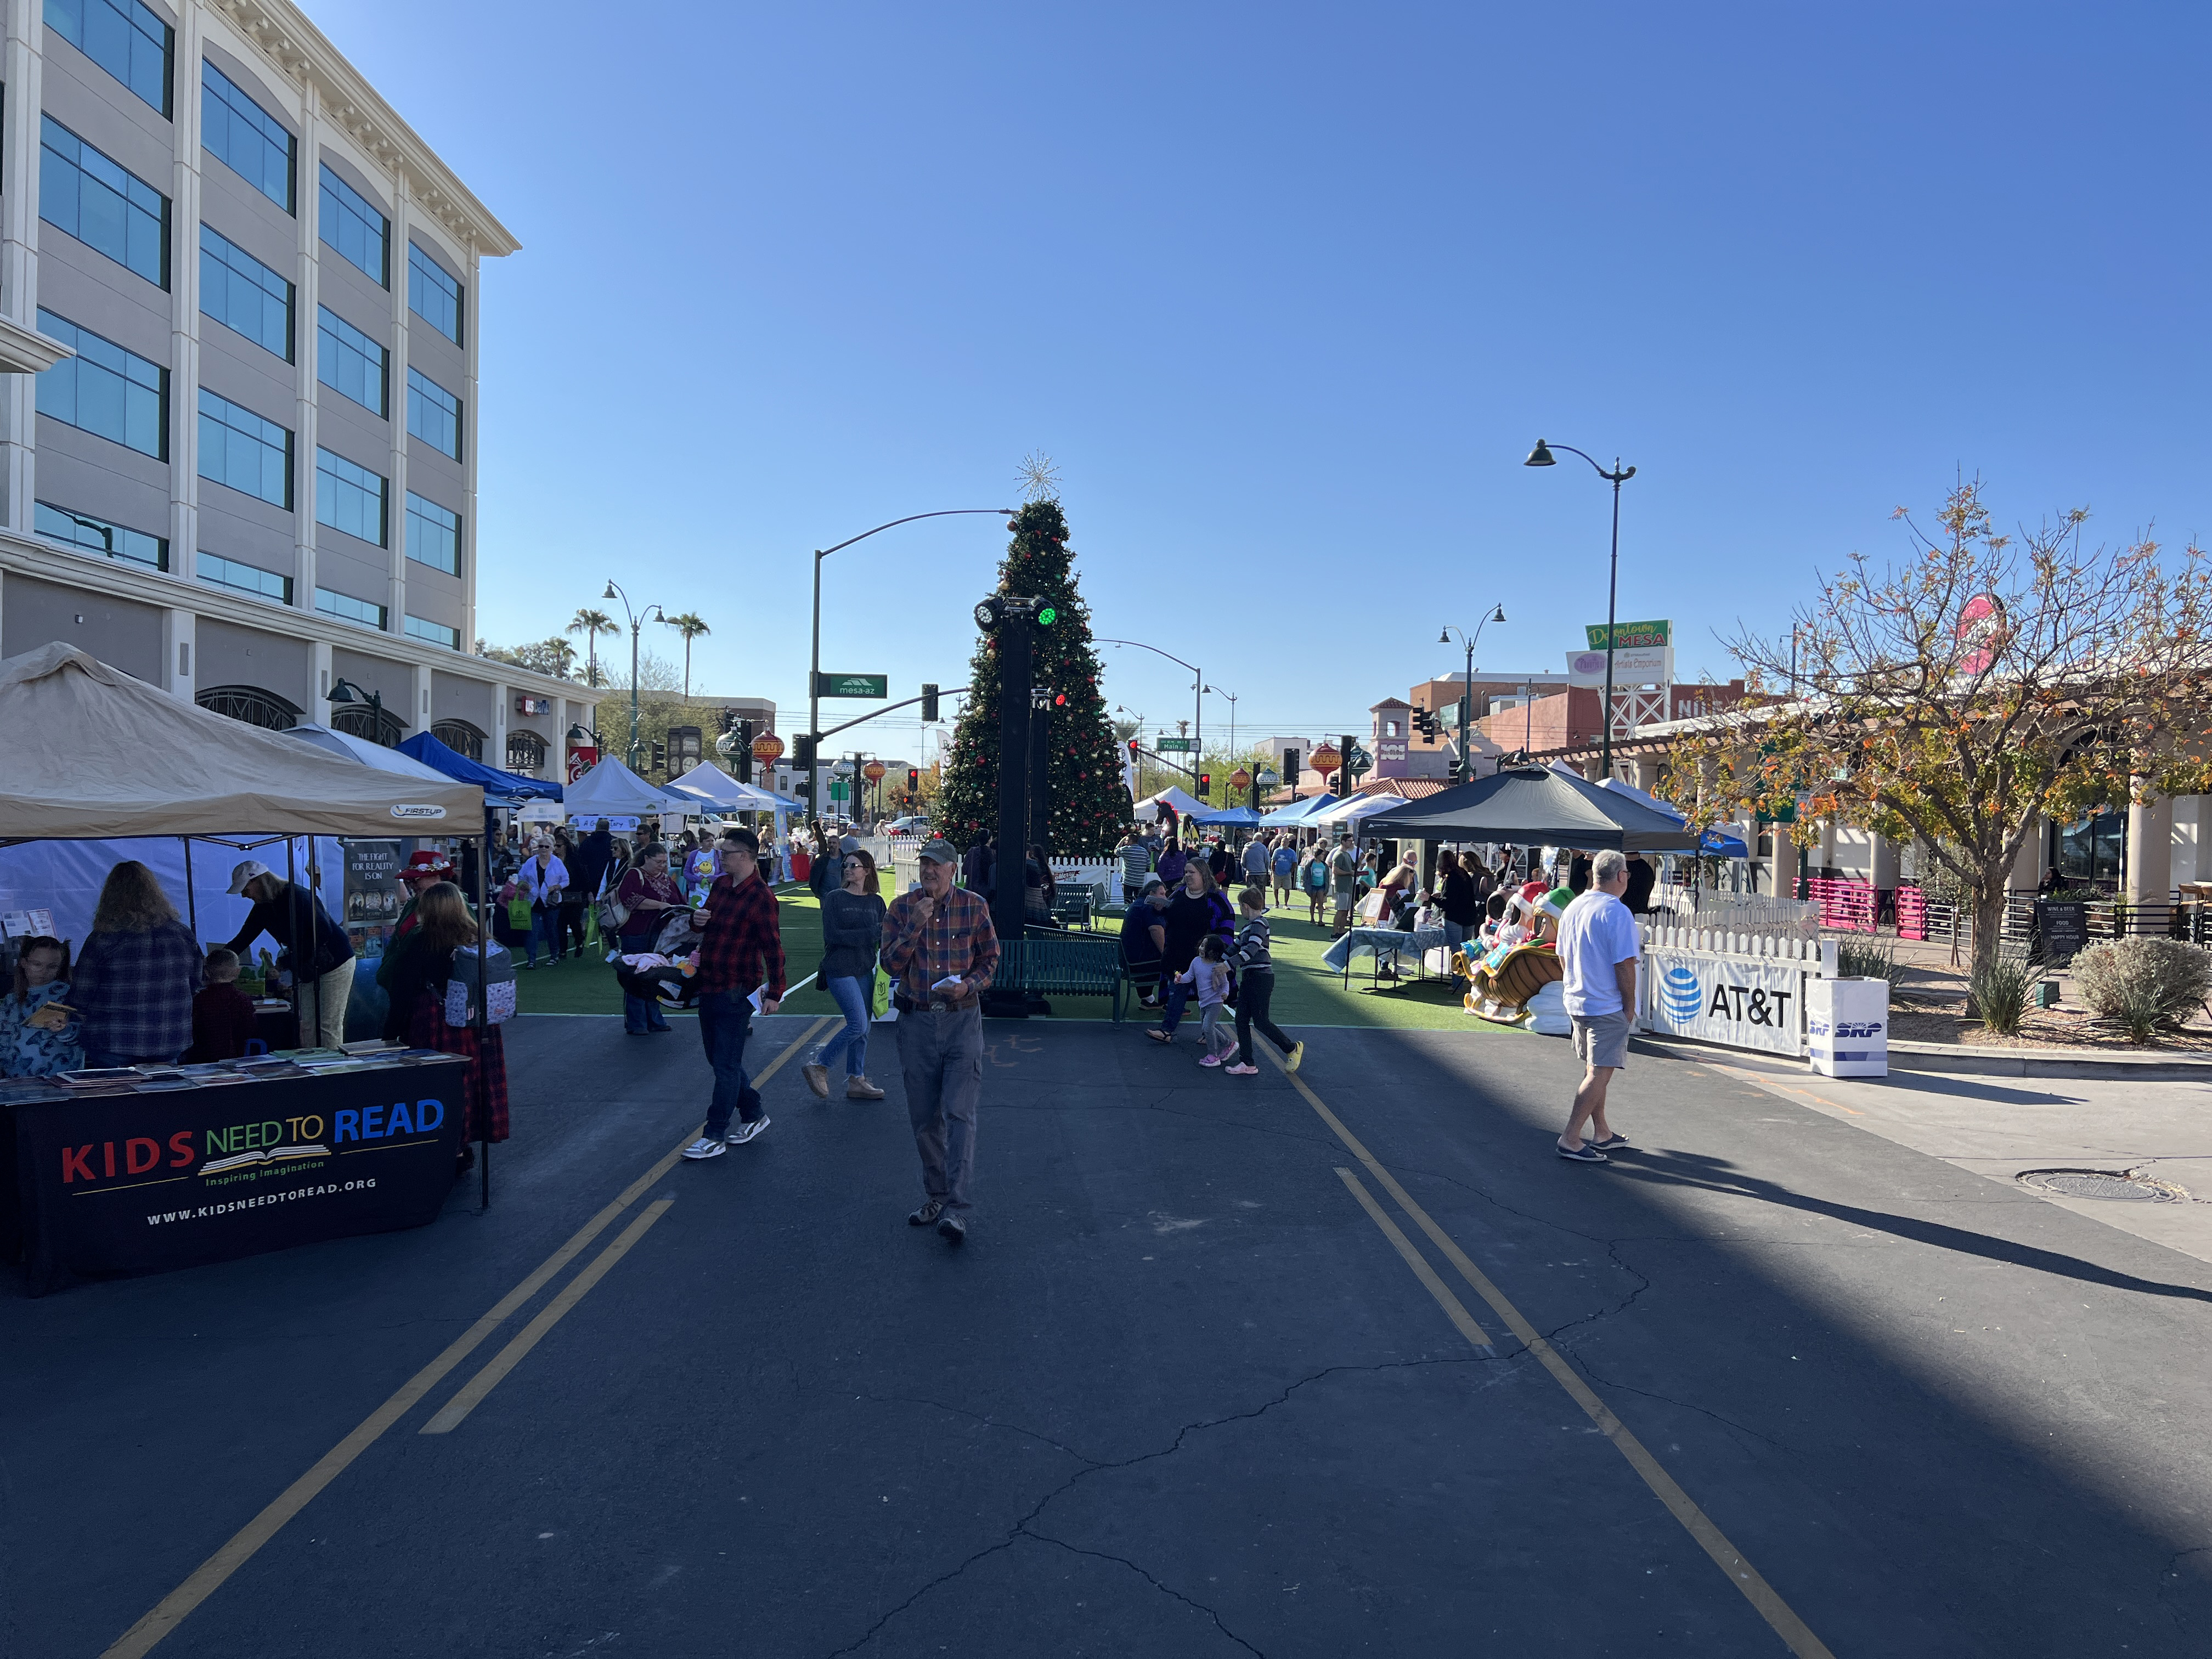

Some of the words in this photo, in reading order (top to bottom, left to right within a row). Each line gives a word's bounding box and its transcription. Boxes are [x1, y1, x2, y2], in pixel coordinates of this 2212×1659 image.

[1619, 633, 1666, 647] MESA
[1615, 659, 1633, 670] Artists
[1634, 658, 1662, 670] Emporium
[370, 853, 388, 861] FIGHT
[366, 862, 394, 870] REALITY
[372, 872, 382, 880] ON
[1708, 984, 1792, 1028] AT&T
[1809, 1020, 1830, 1036] SRP
[1835, 1022, 1882, 1037] SRP
[62, 1131, 195, 1183] KIDS
[206, 1121, 283, 1155] NEED
[285, 1115, 324, 1142] TO
[334, 1099, 444, 1143] READ
[206, 1171, 256, 1187] Inspiring
[259, 1160, 325, 1178] Imagination
[147, 1178, 376, 1226] WWW.KIDSNEEDTOREAD.ORG
